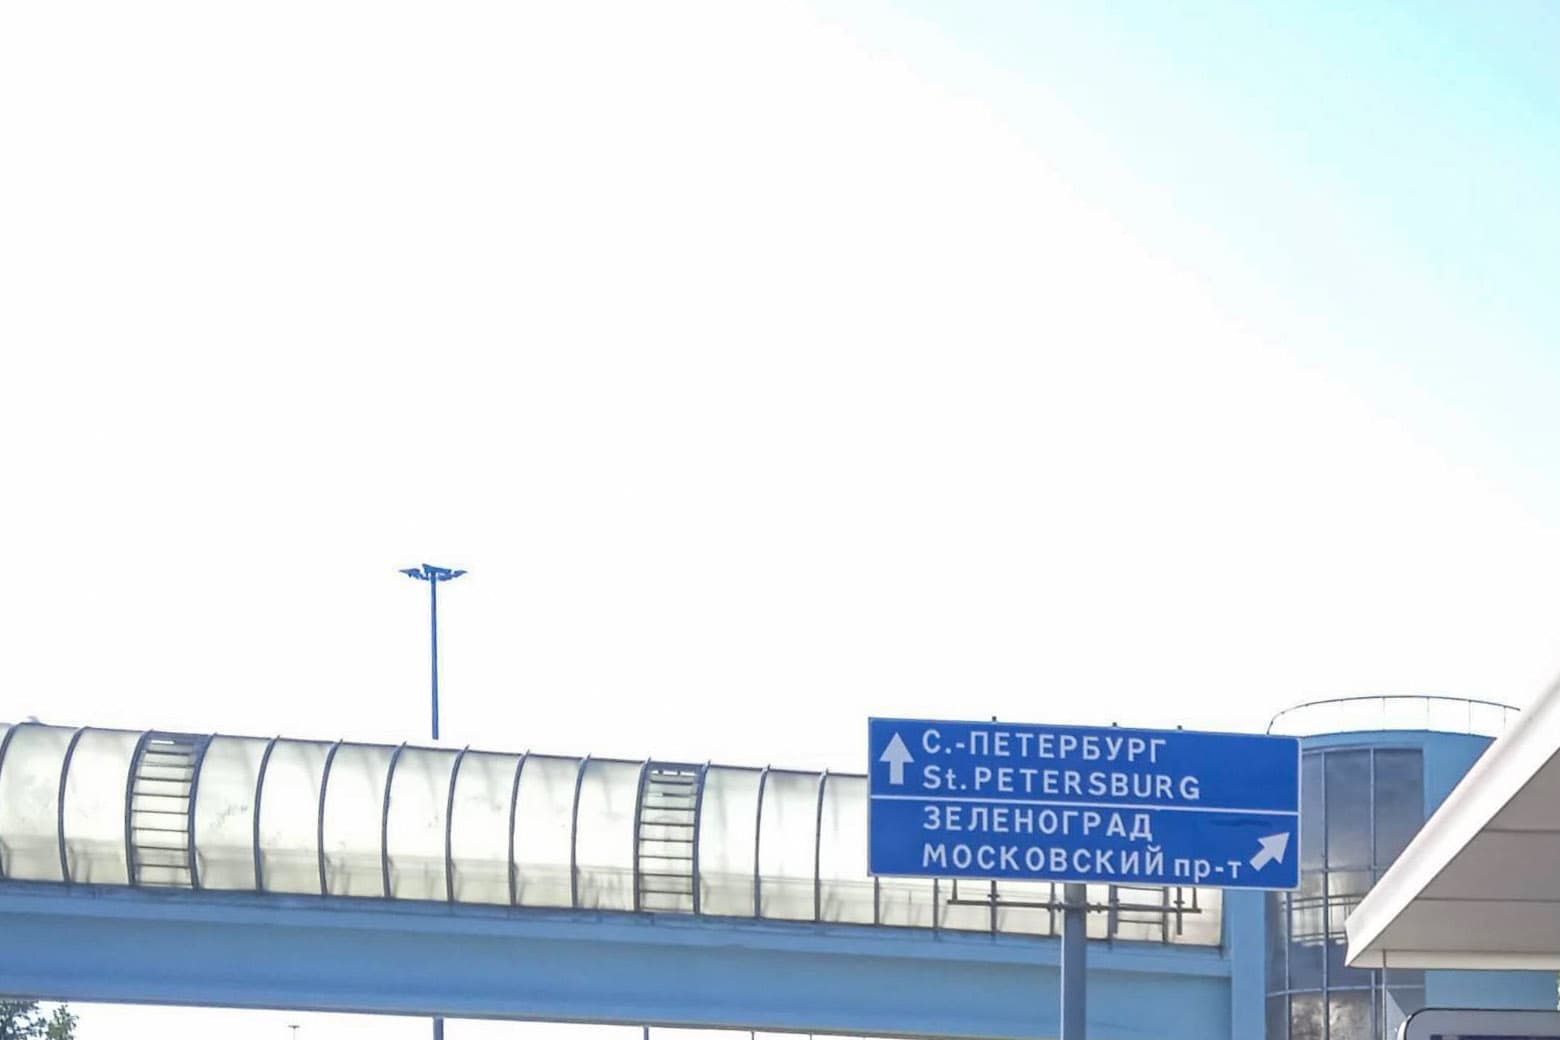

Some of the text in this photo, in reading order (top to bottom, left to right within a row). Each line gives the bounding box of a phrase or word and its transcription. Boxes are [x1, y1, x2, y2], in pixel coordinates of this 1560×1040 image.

[922, 730, 1166, 763] С.-ПЕТЕРБУРГ
[924, 806, 1153, 842] ЗЕЛЕНОГРАД
[923, 844, 1242, 884] МОСКОВСКИЙ пр-т
